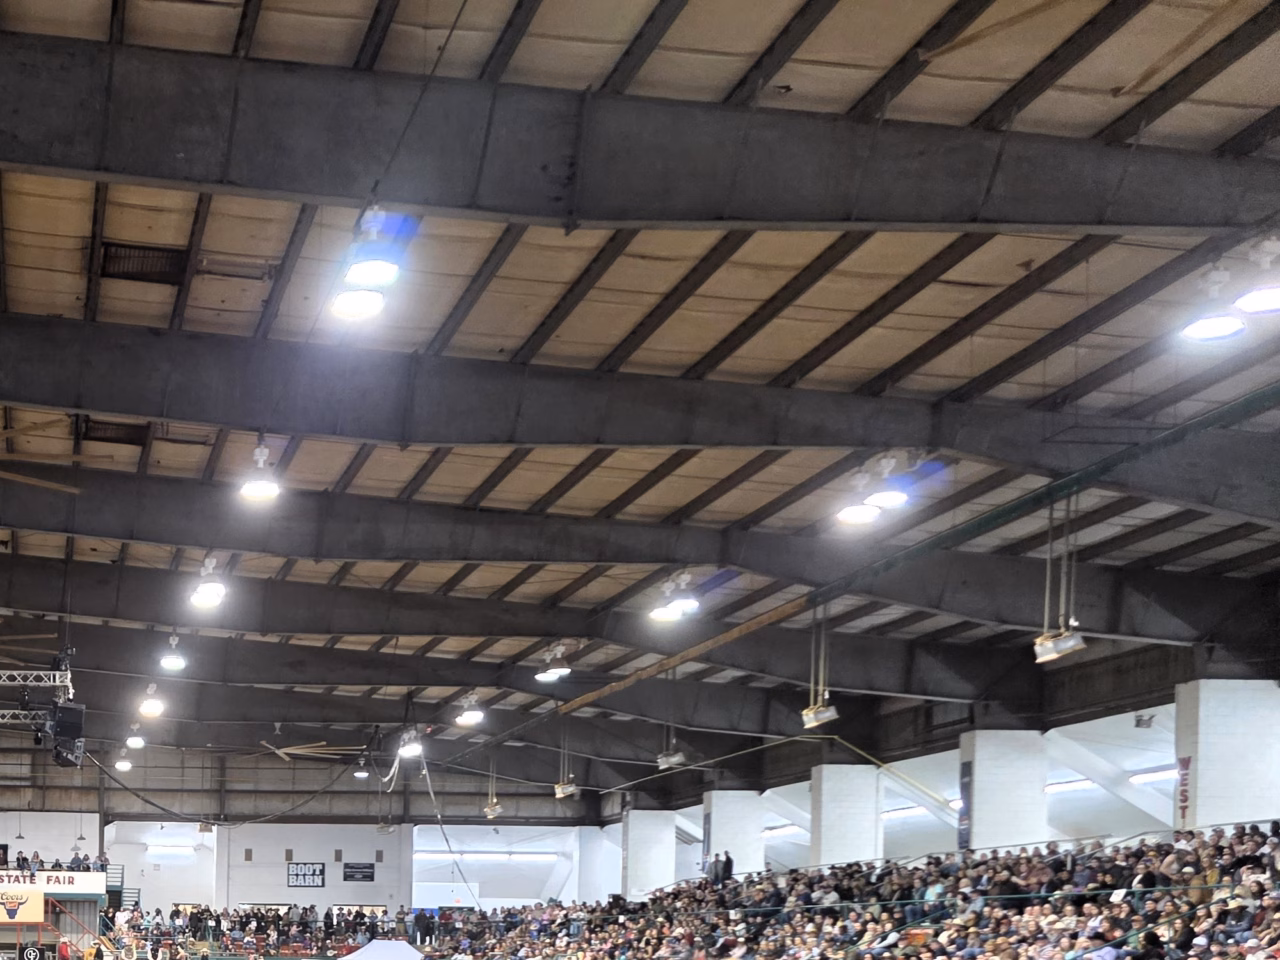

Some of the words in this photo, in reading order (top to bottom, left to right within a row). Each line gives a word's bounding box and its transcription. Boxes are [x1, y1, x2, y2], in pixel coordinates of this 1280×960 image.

[1178, 756, 1192, 819] WEST
[288, 864, 323, 875] BOOT
[46, 875, 75, 885] FAIR
[288, 875, 323, 886] BARN
